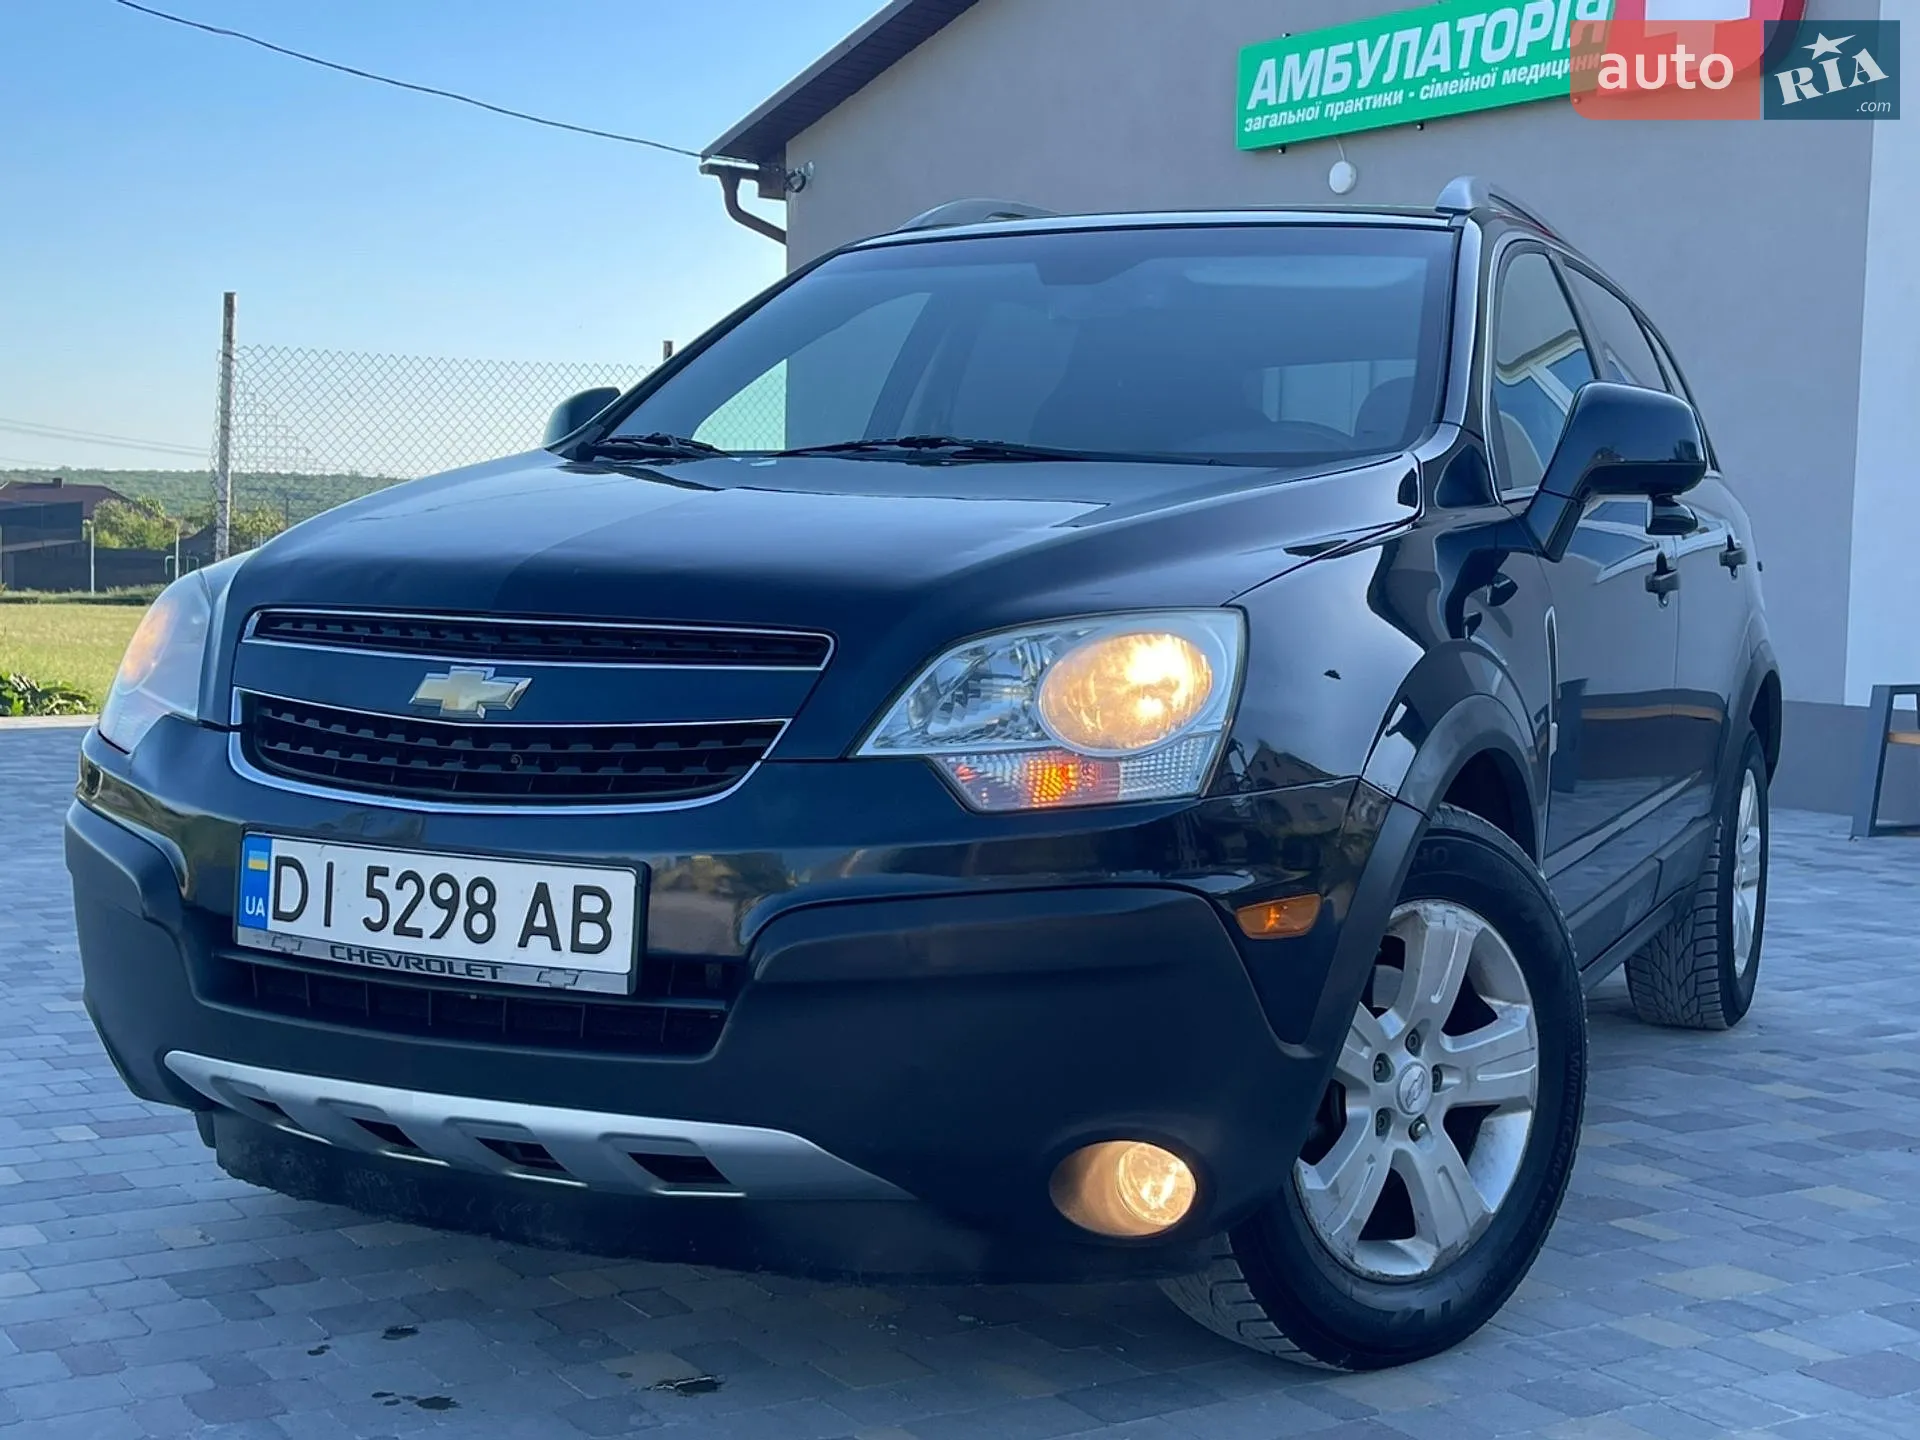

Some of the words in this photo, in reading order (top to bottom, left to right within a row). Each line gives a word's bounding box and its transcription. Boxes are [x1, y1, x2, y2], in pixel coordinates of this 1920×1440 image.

[1244, 101, 1321, 132] загальної
[1324, 90, 1404, 121] практики
[1419, 67, 1497, 100] сімейної
[1501, 53, 1600, 86] медицини
[1246, 0, 1610, 110] АМБУЛАТОРІЯ
[245, 895, 266, 917] UA
[272, 855, 334, 928] DI
[362, 865, 497, 944] 5298
[517, 882, 613, 955] AB
[330, 945, 504, 980] CHEVROLET
